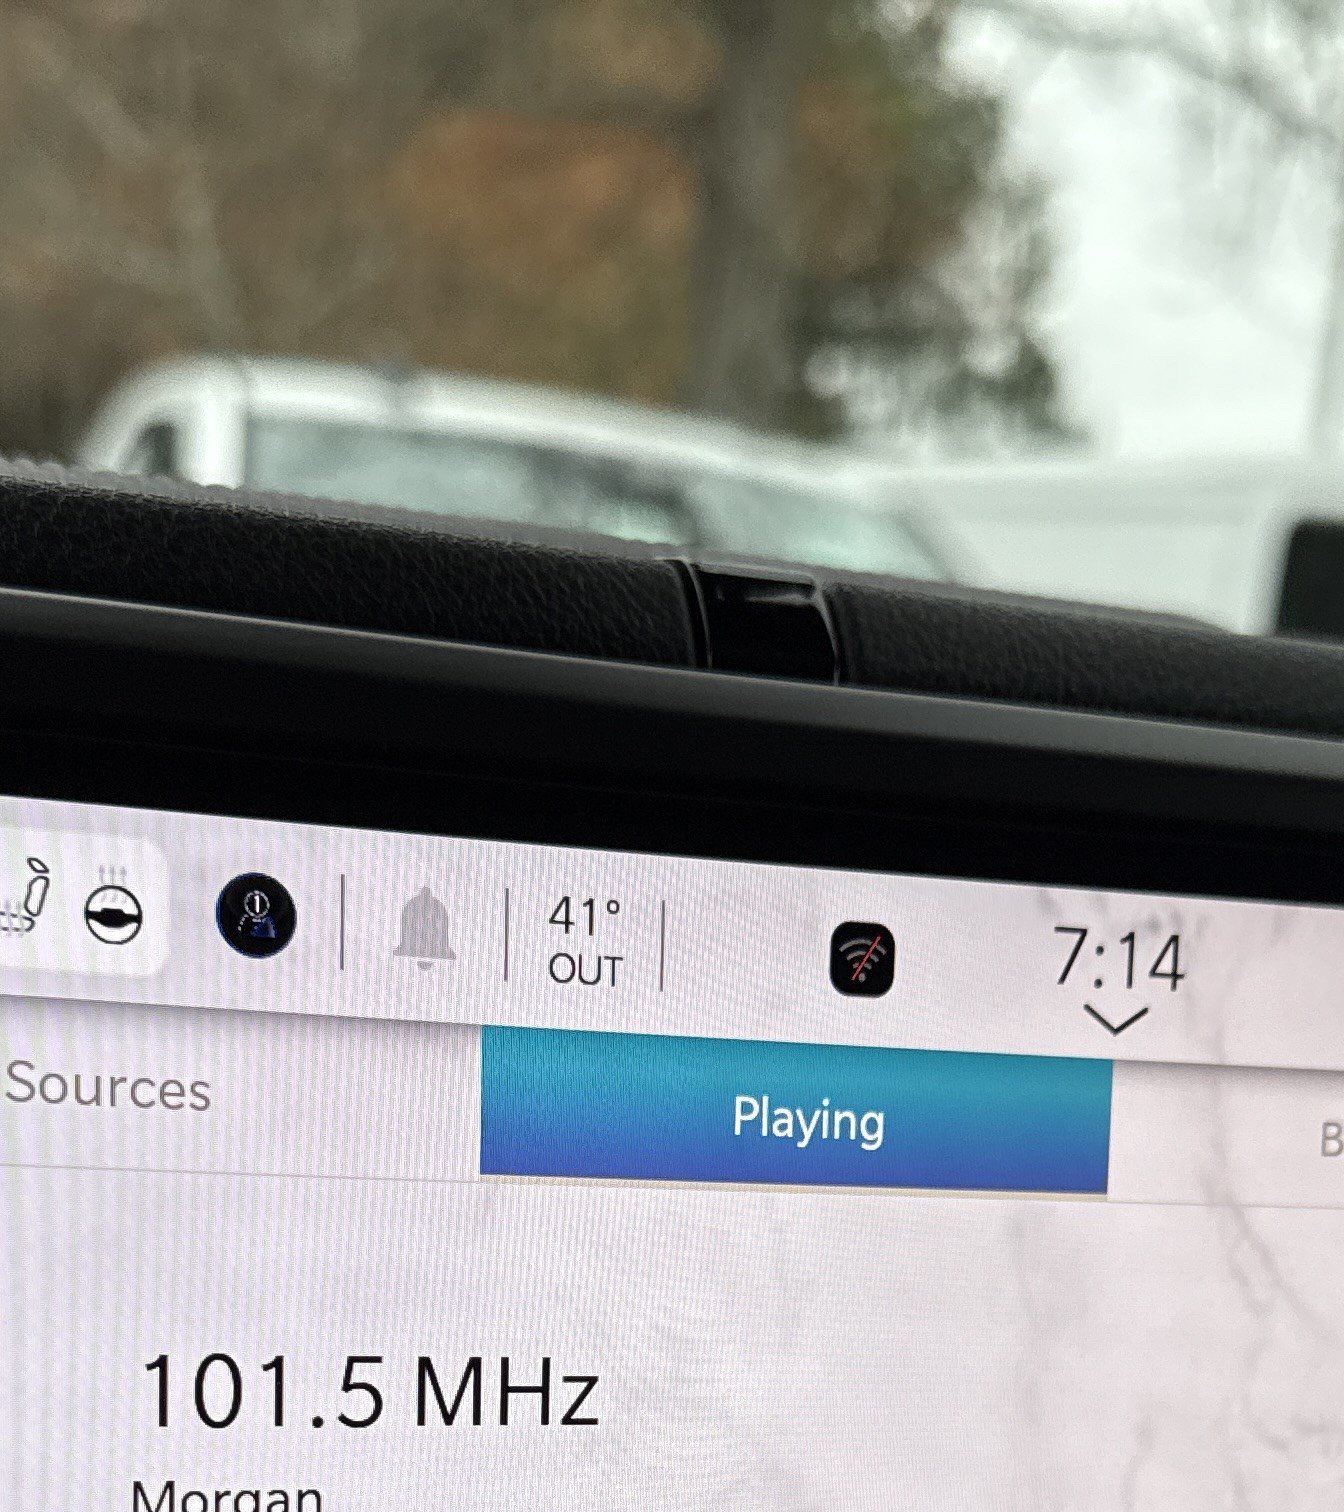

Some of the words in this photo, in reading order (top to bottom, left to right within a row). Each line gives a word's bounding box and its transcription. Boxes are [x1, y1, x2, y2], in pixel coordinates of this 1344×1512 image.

[550, 897, 620, 936] 41°
[550, 954, 624, 987] OUT
[1056, 927, 1185, 991] 7:14
[7, 1061, 211, 1112] Sources
[736, 1097, 884, 1151] Playing
[147, 1354, 383, 1429] 101.5
[418, 1358, 599, 1427] MHz
